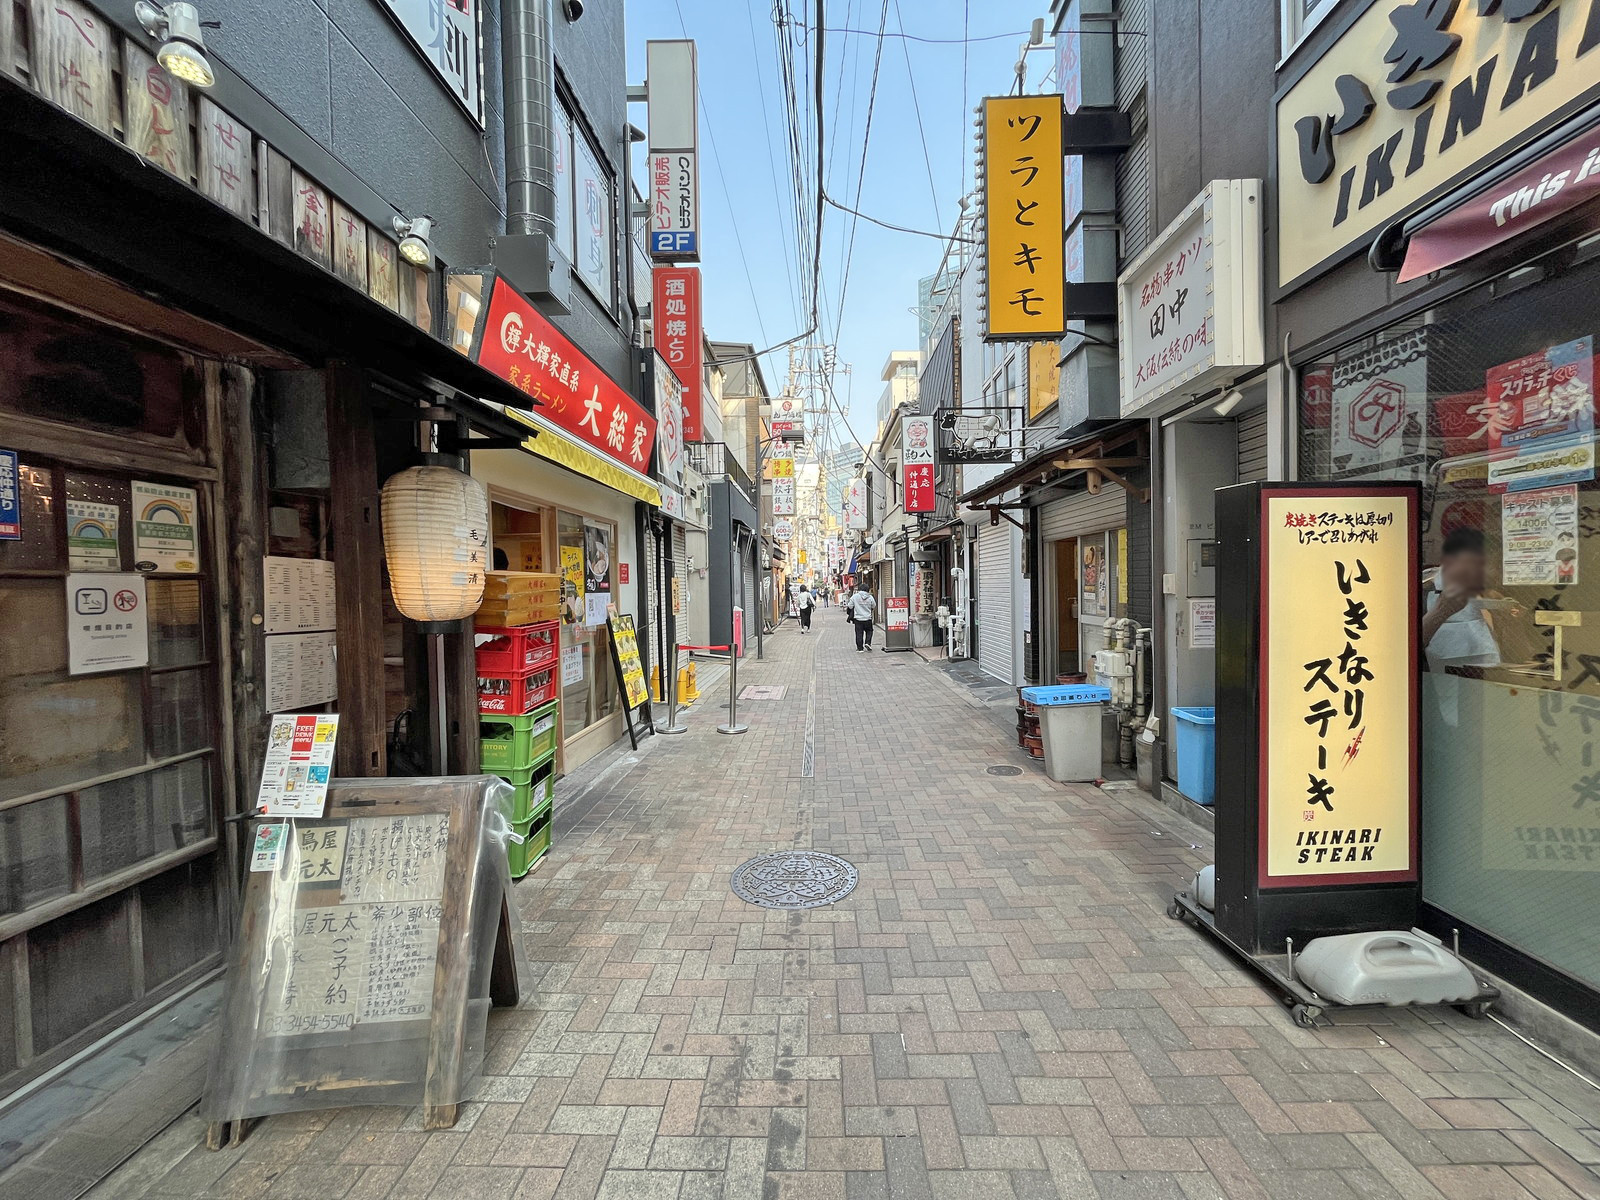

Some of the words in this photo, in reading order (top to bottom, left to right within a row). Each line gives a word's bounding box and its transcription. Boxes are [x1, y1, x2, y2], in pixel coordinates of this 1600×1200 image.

[1294, 0, 1556, 184] いき
[655, 157, 671, 229] ビデオ販売
[1007, 114, 1044, 316] ツラとキモ
[1489, 170, 1572, 227] This
[658, 233, 690, 250] 2F
[1139, 237, 1202, 309] 名物串カツ
[665, 279, 687, 363] 酒処焼とり
[1150, 287, 1188, 340] 田中
[521, 332, 580, 393] 大輝家直系
[1135, 317, 1207, 388] 大阪伝統の味
[508, 364, 567, 414] 家系ラーメン
[578, 384, 648, 463] 大総家
[909, 470, 919, 508] 仲通り店
[920, 466, 930, 488] 慶応
[1284, 512, 1393, 528] 炭焼きステーキは厚切り
[1334, 558, 1374, 731] いきなり
[1303, 657, 1340, 812] ステーキ
[301, 830, 337, 852] 鳥屋
[386, 820, 404, 880] 揚げもの
[434, 819, 449, 852] 名物
[1296, 828, 1382, 846] IKINARI
[1298, 846, 1375, 863] STEAK
[300, 858, 336, 879] 元太
[371, 905, 443, 922] 希少部位
[325, 936, 354, 1004] ご予約
[264, 1013, 355, 1033] 03-3454-5540
